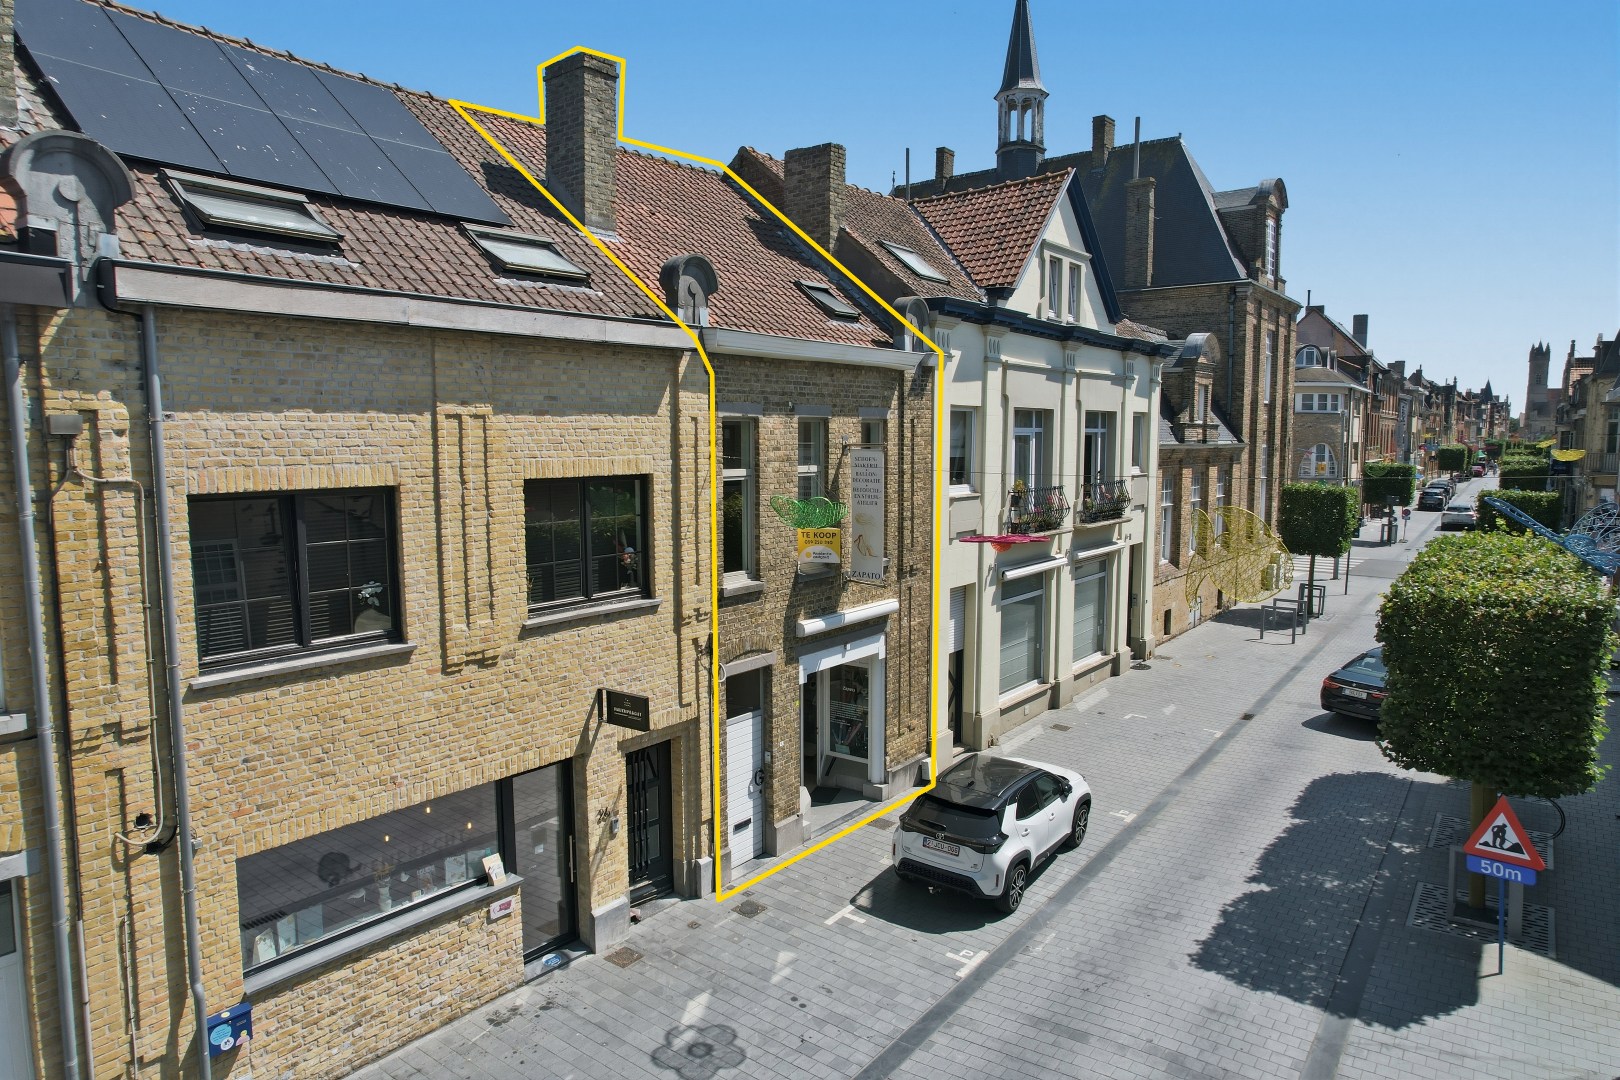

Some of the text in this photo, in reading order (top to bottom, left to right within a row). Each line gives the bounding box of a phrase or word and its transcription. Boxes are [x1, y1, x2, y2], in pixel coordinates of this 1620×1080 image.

[813, 531, 837, 539] KOOP
[851, 570, 881, 580] ZAPATO
[1480, 859, 1521, 882] 50m
